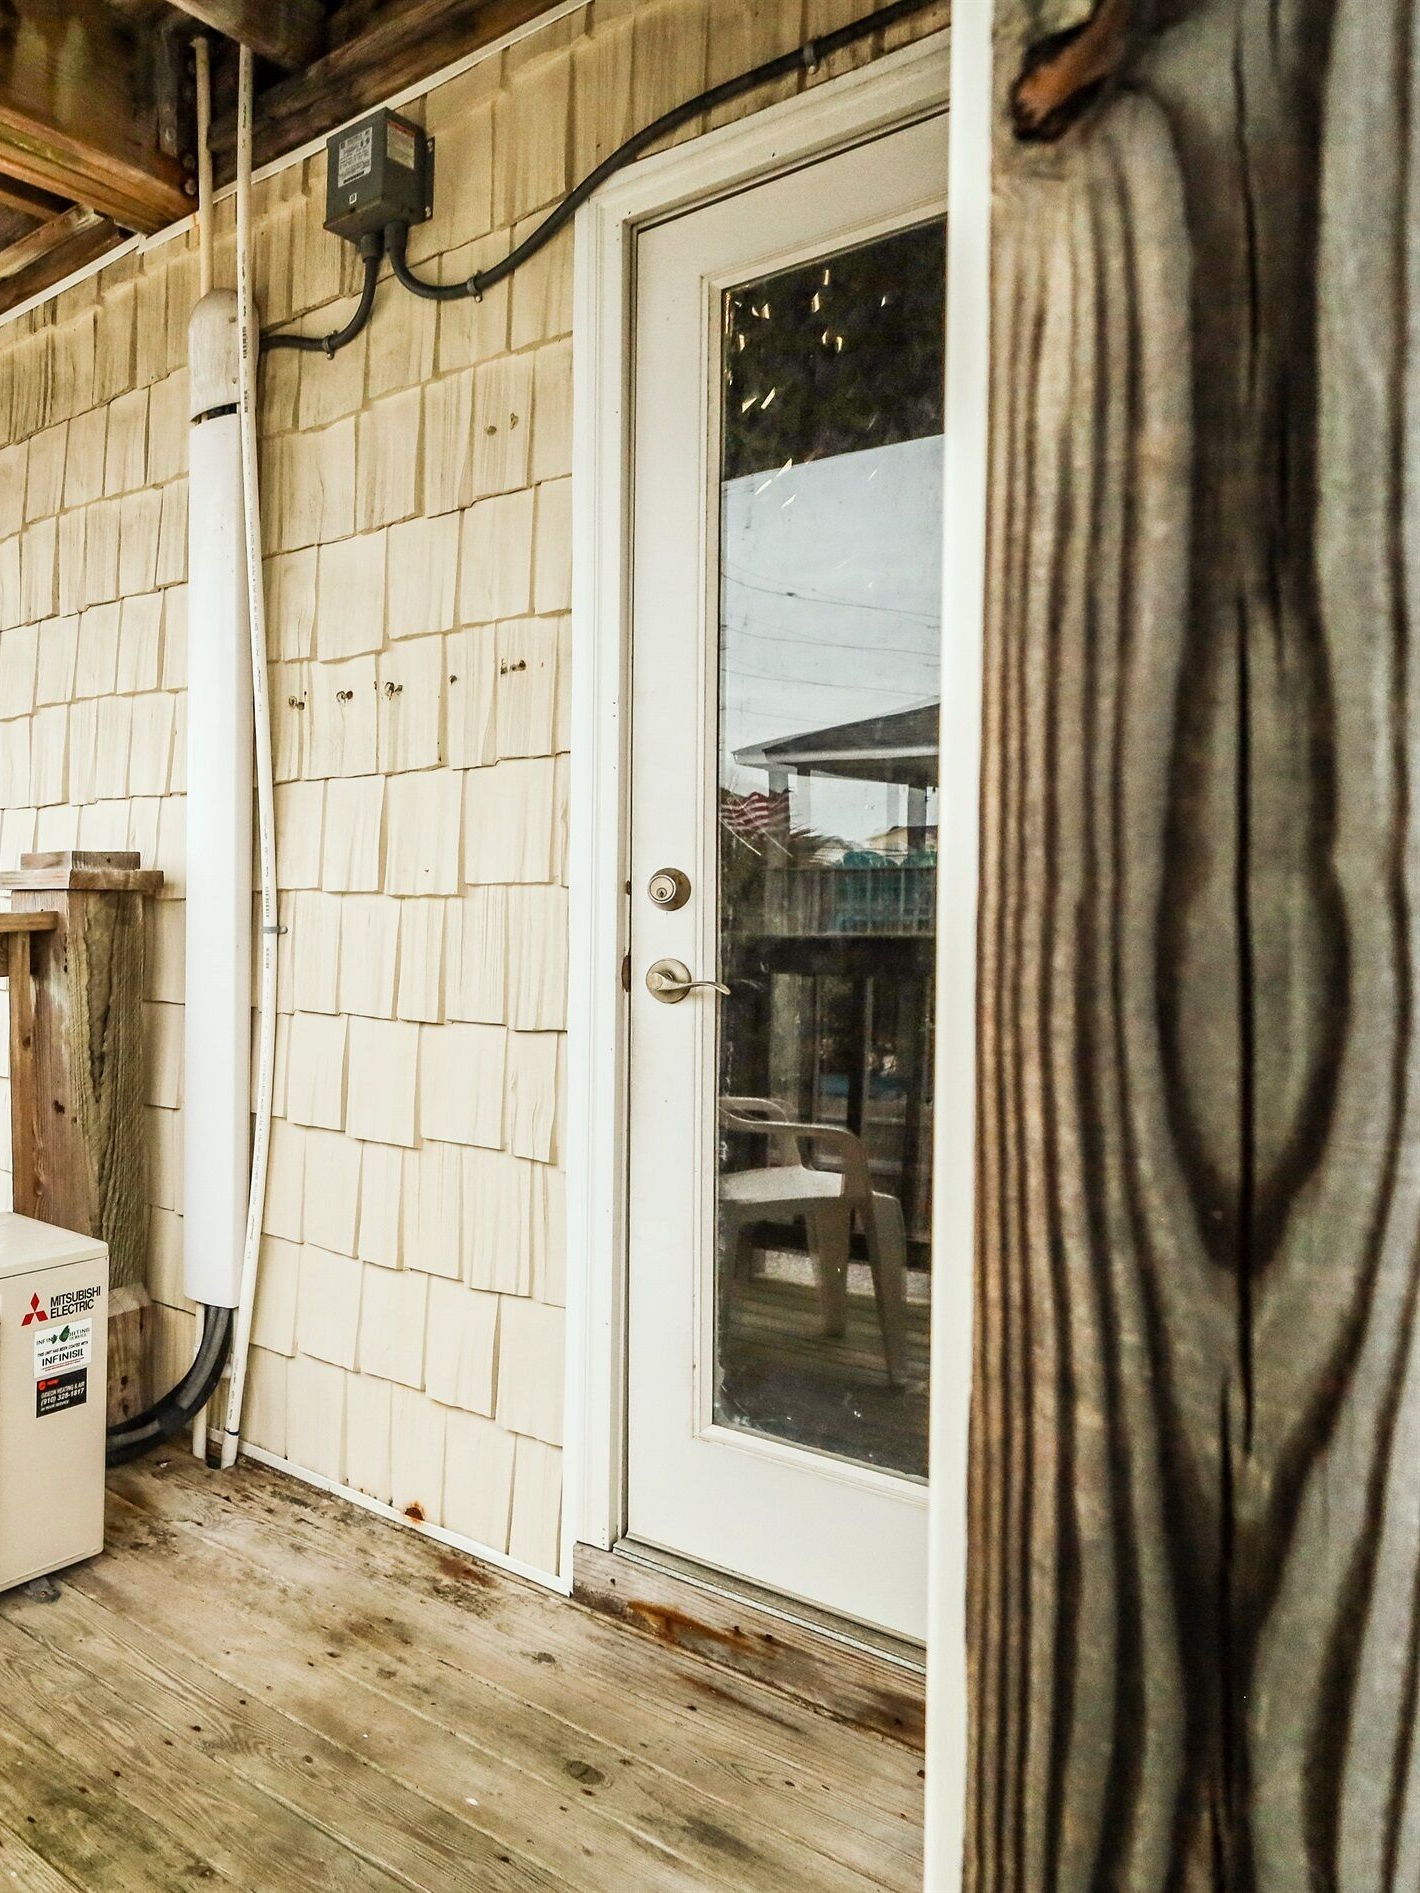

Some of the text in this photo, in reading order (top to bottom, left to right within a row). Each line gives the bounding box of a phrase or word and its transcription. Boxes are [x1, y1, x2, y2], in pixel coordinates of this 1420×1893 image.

[50, 1286, 101, 1307] MITSUBISHI
[50, 1298, 94, 1319] ELECTRIC
[42, 1348, 84, 1366] INFINISIL
